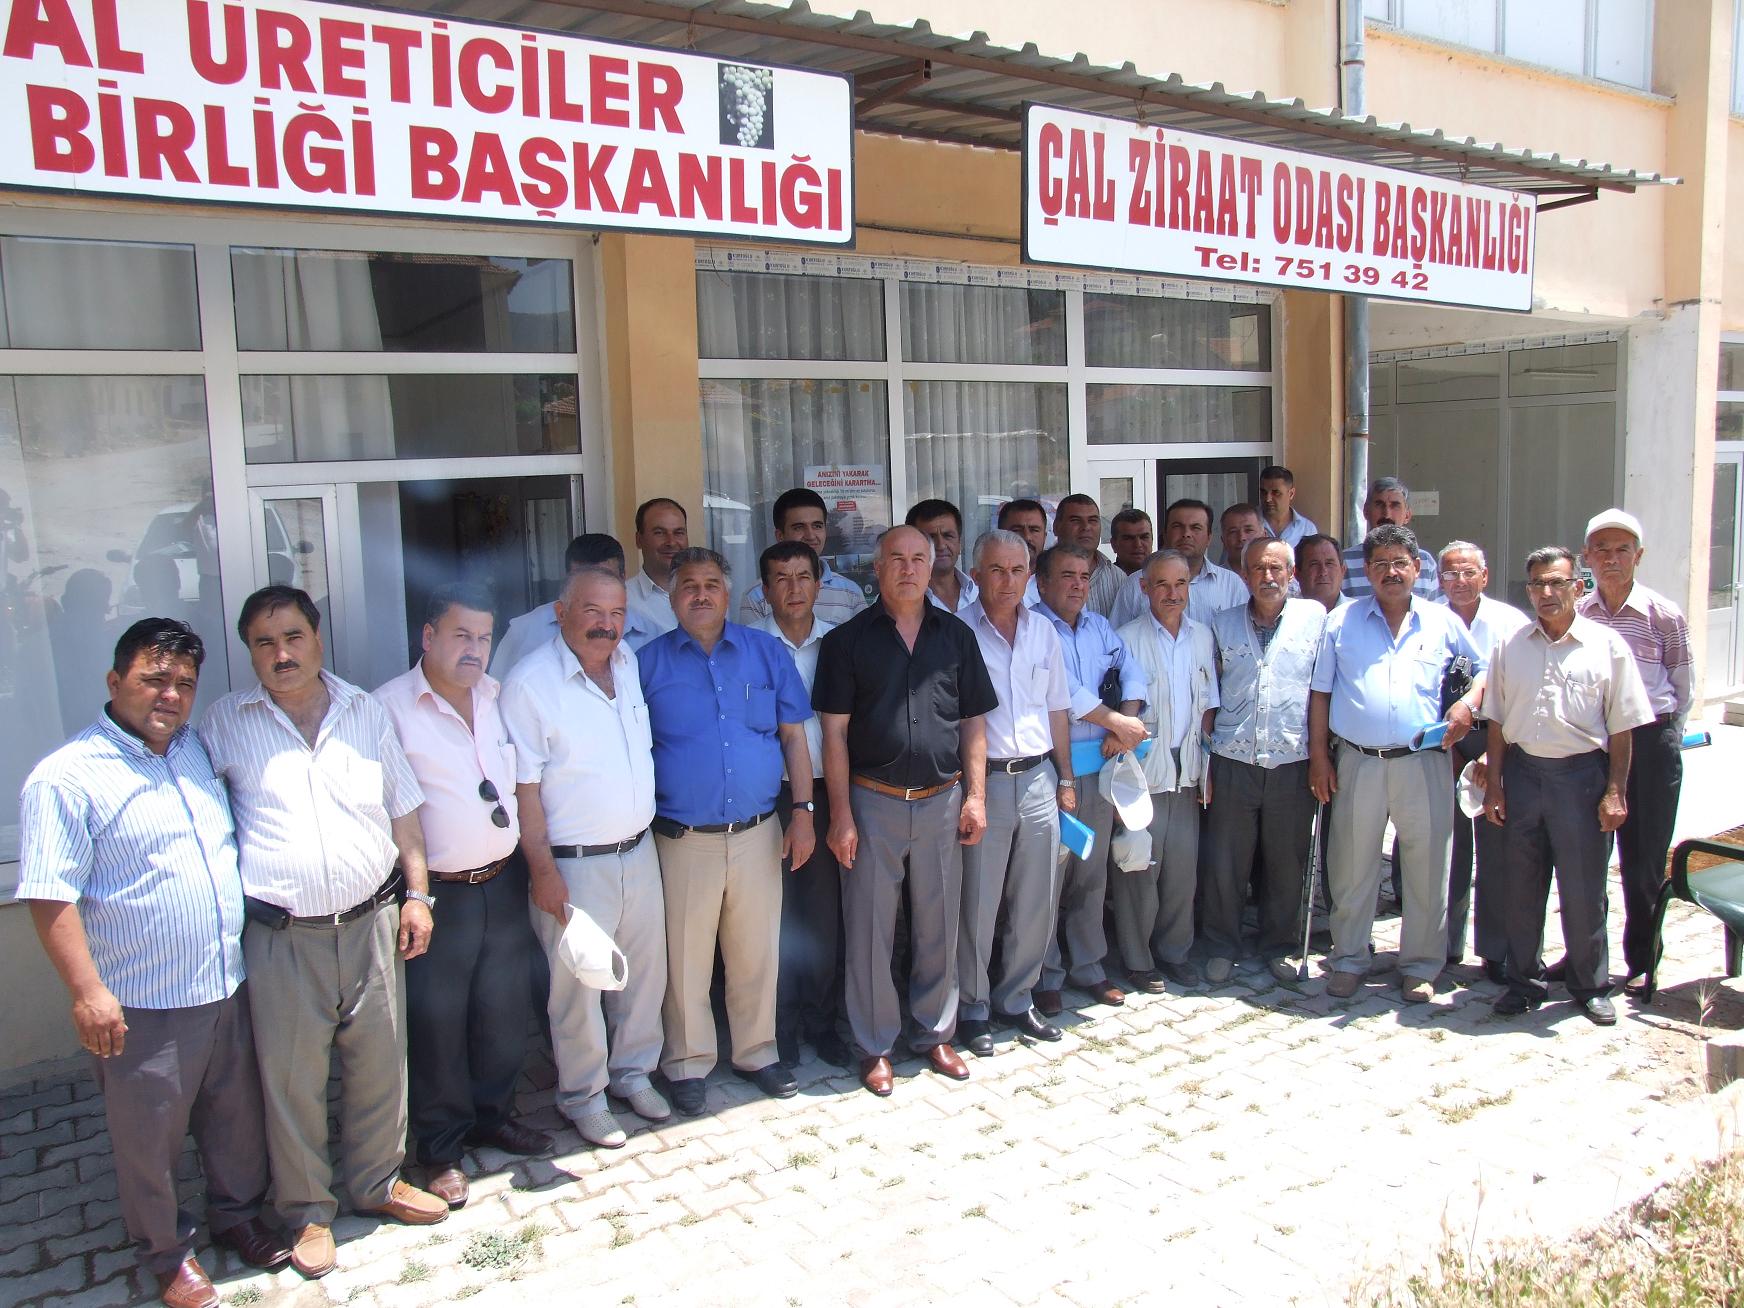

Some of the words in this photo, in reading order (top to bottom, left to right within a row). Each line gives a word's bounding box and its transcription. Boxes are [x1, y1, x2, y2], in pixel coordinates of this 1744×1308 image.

[26, 79, 376, 197] BİRLİĞİ
[409, 125, 843, 231] BAŞKANLIĞI
[1038, 122, 1116, 226] ÇAL
[1128, 128, 1264, 239] ZİRAAT
[1272, 161, 1366, 254] ODASI
[1372, 181, 1530, 275] BAŞKANLIĞI
[1194, 245, 1262, 274] Tel:
[1275, 255, 1333, 281] 751
[1343, 263, 1381, 287] 39
[1390, 270, 1430, 292] 42
